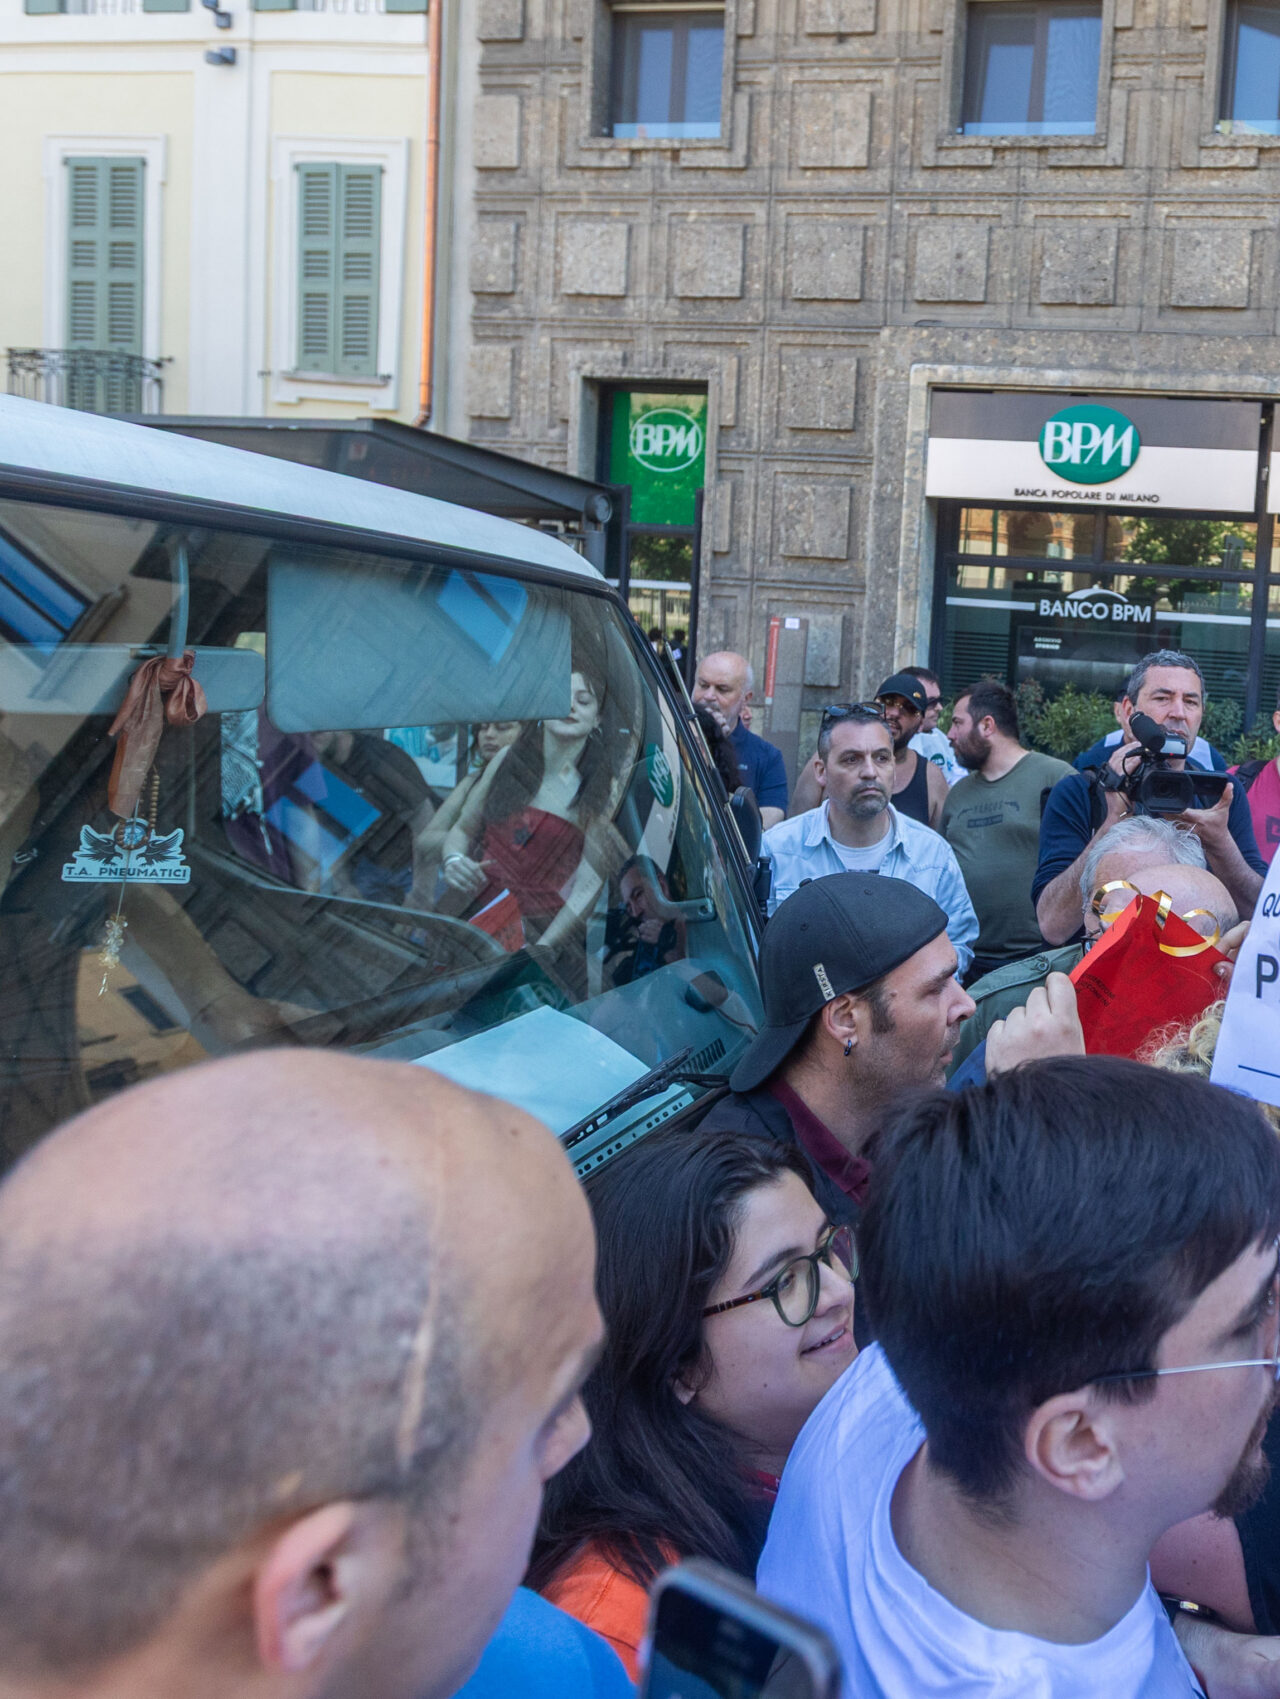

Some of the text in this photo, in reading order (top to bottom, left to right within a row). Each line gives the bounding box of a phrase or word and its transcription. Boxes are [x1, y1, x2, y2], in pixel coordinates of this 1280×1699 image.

[635, 424, 697, 458] BPM
[1044, 422, 1134, 466] BPM
[1014, 488, 1160, 503] BANCA POPOLARE DI MILANO
[1039, 598, 1153, 623] BANCO BPM
[66, 866, 187, 878] T.A. PNEUMATICI
